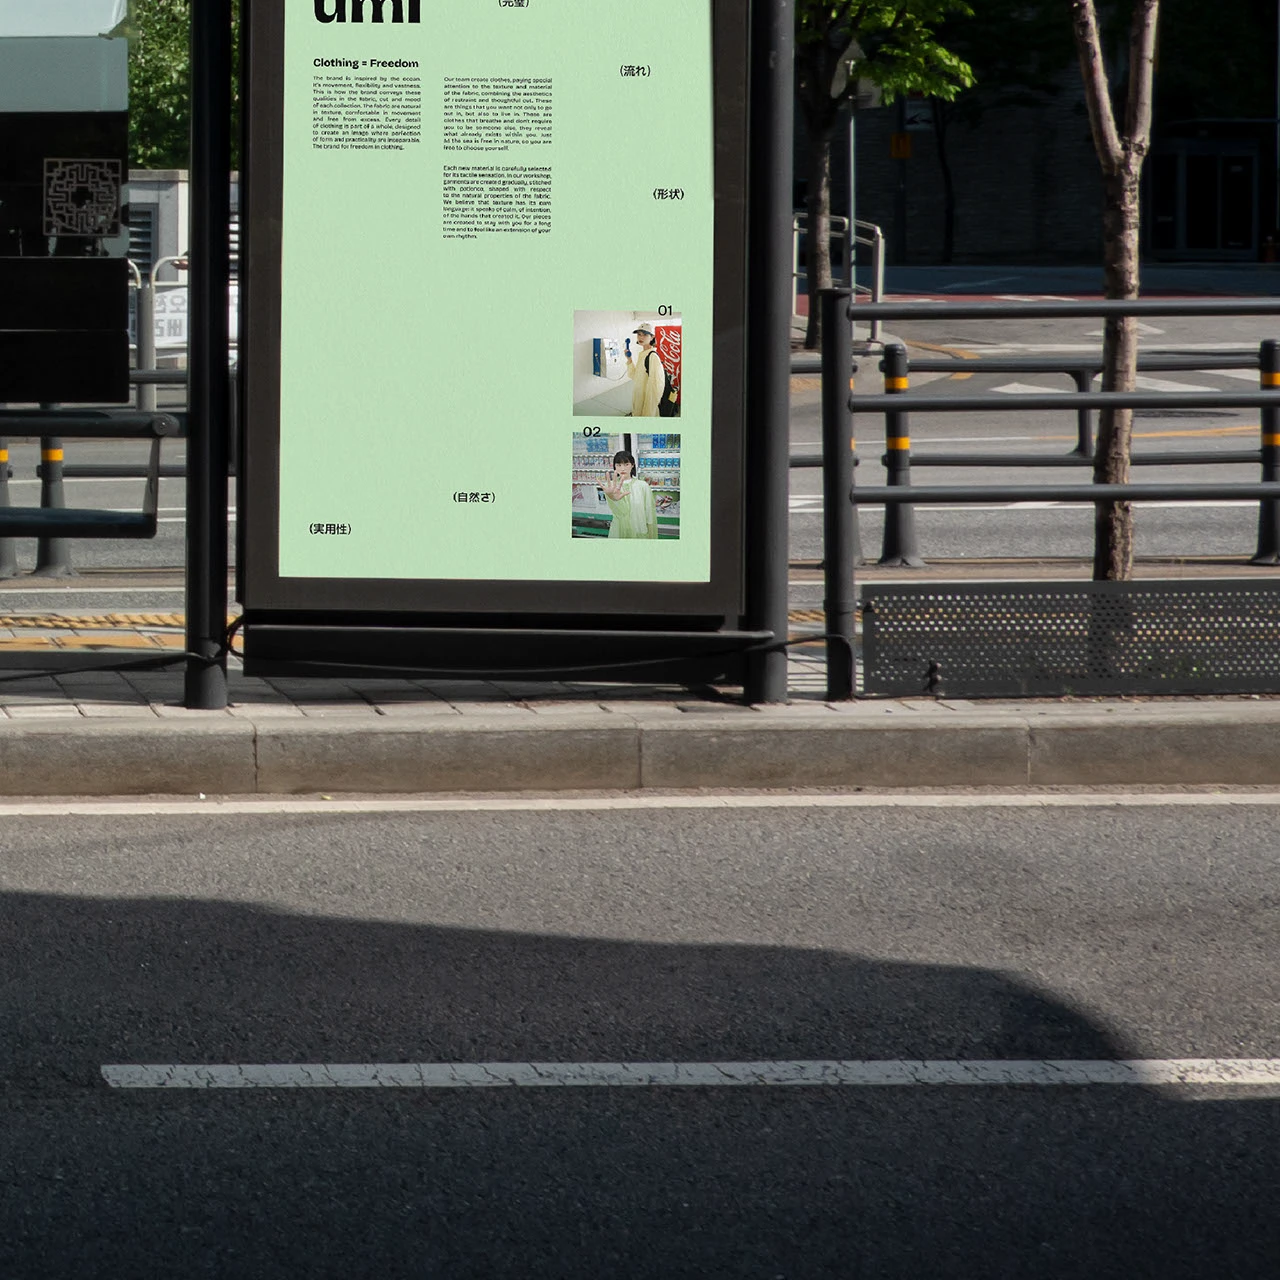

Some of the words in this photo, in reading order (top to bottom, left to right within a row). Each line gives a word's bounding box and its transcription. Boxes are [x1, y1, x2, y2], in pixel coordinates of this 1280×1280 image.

[313, 57, 360, 70] Clothing
[370, 58, 419, 68] Freedom
[619, 64, 651, 77] (流れ)
[652, 188, 685, 201] (形状)
[657, 304, 672, 316] 01
[583, 426, 601, 438] 02
[453, 491, 496, 504] (自然さ)
[309, 522, 352, 536] (実用性)
